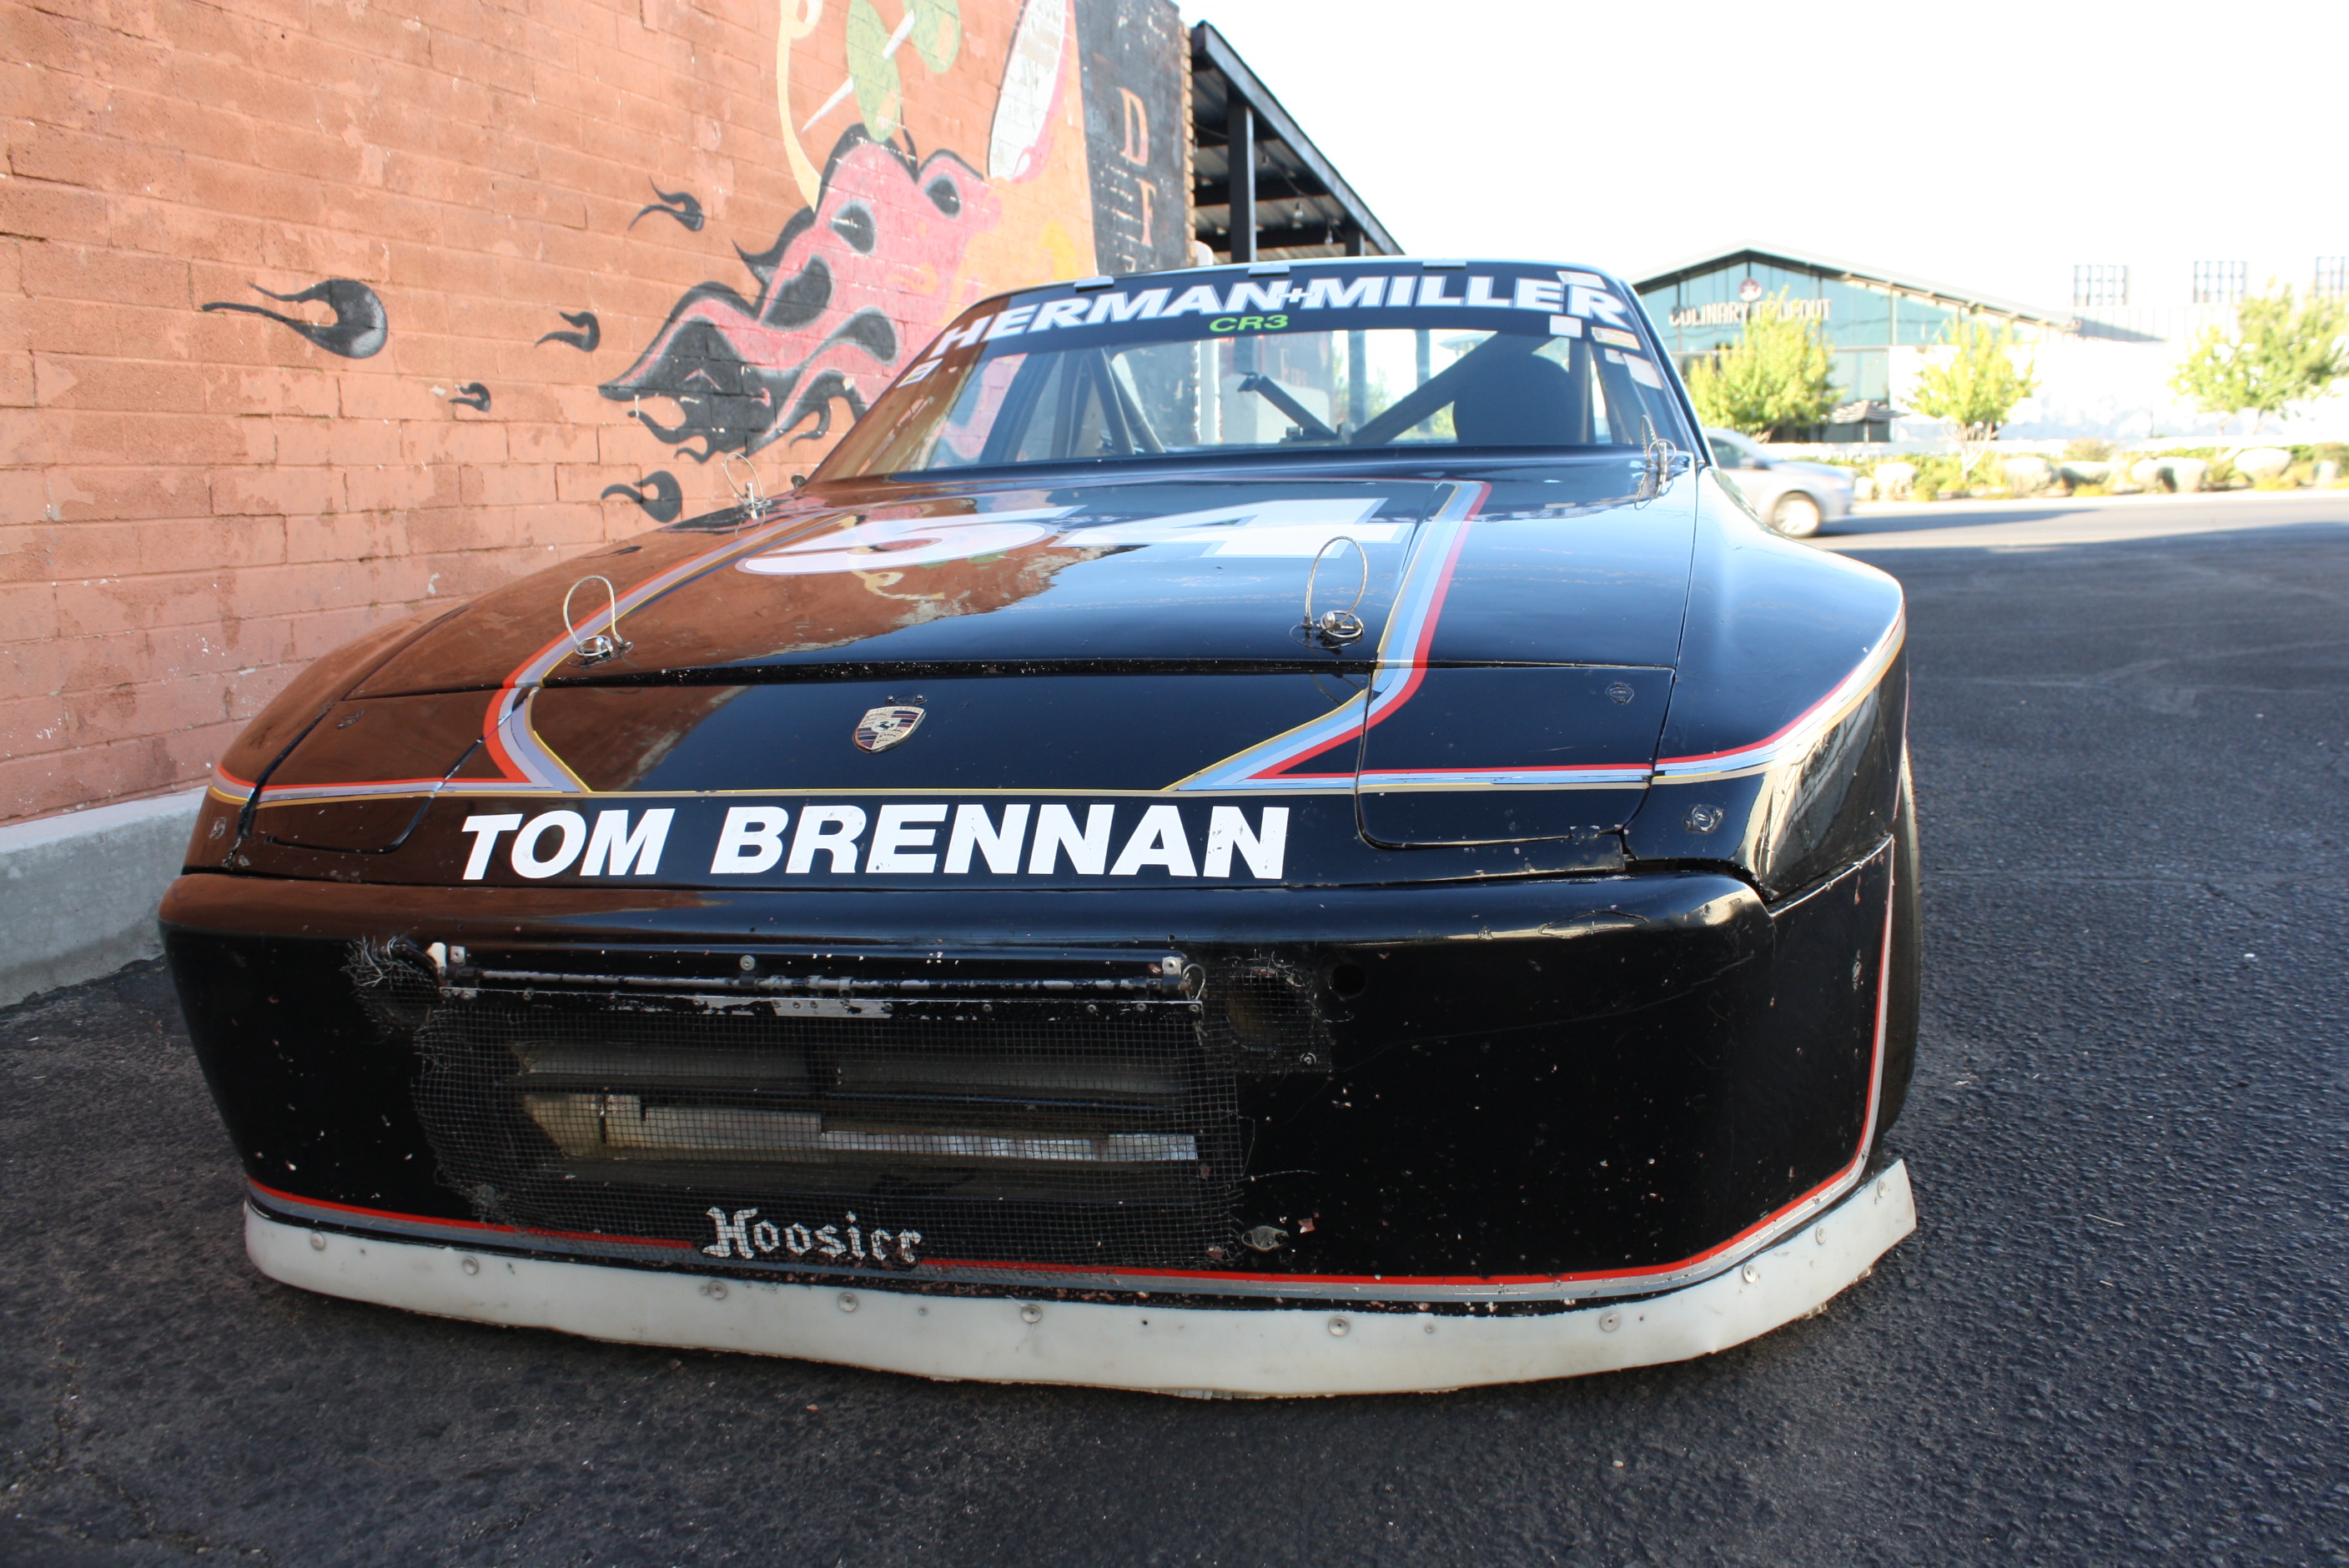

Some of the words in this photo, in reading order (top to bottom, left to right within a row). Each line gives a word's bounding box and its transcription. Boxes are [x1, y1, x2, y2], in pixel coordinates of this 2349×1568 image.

[1210, 314, 1289, 333] CR3
[1668, 301, 1750, 327] CULINARY
[461, 807, 677, 880] TOM
[710, 803, 1290, 880] BRENNAN
[702, 1206, 922, 1263] Hoosier
